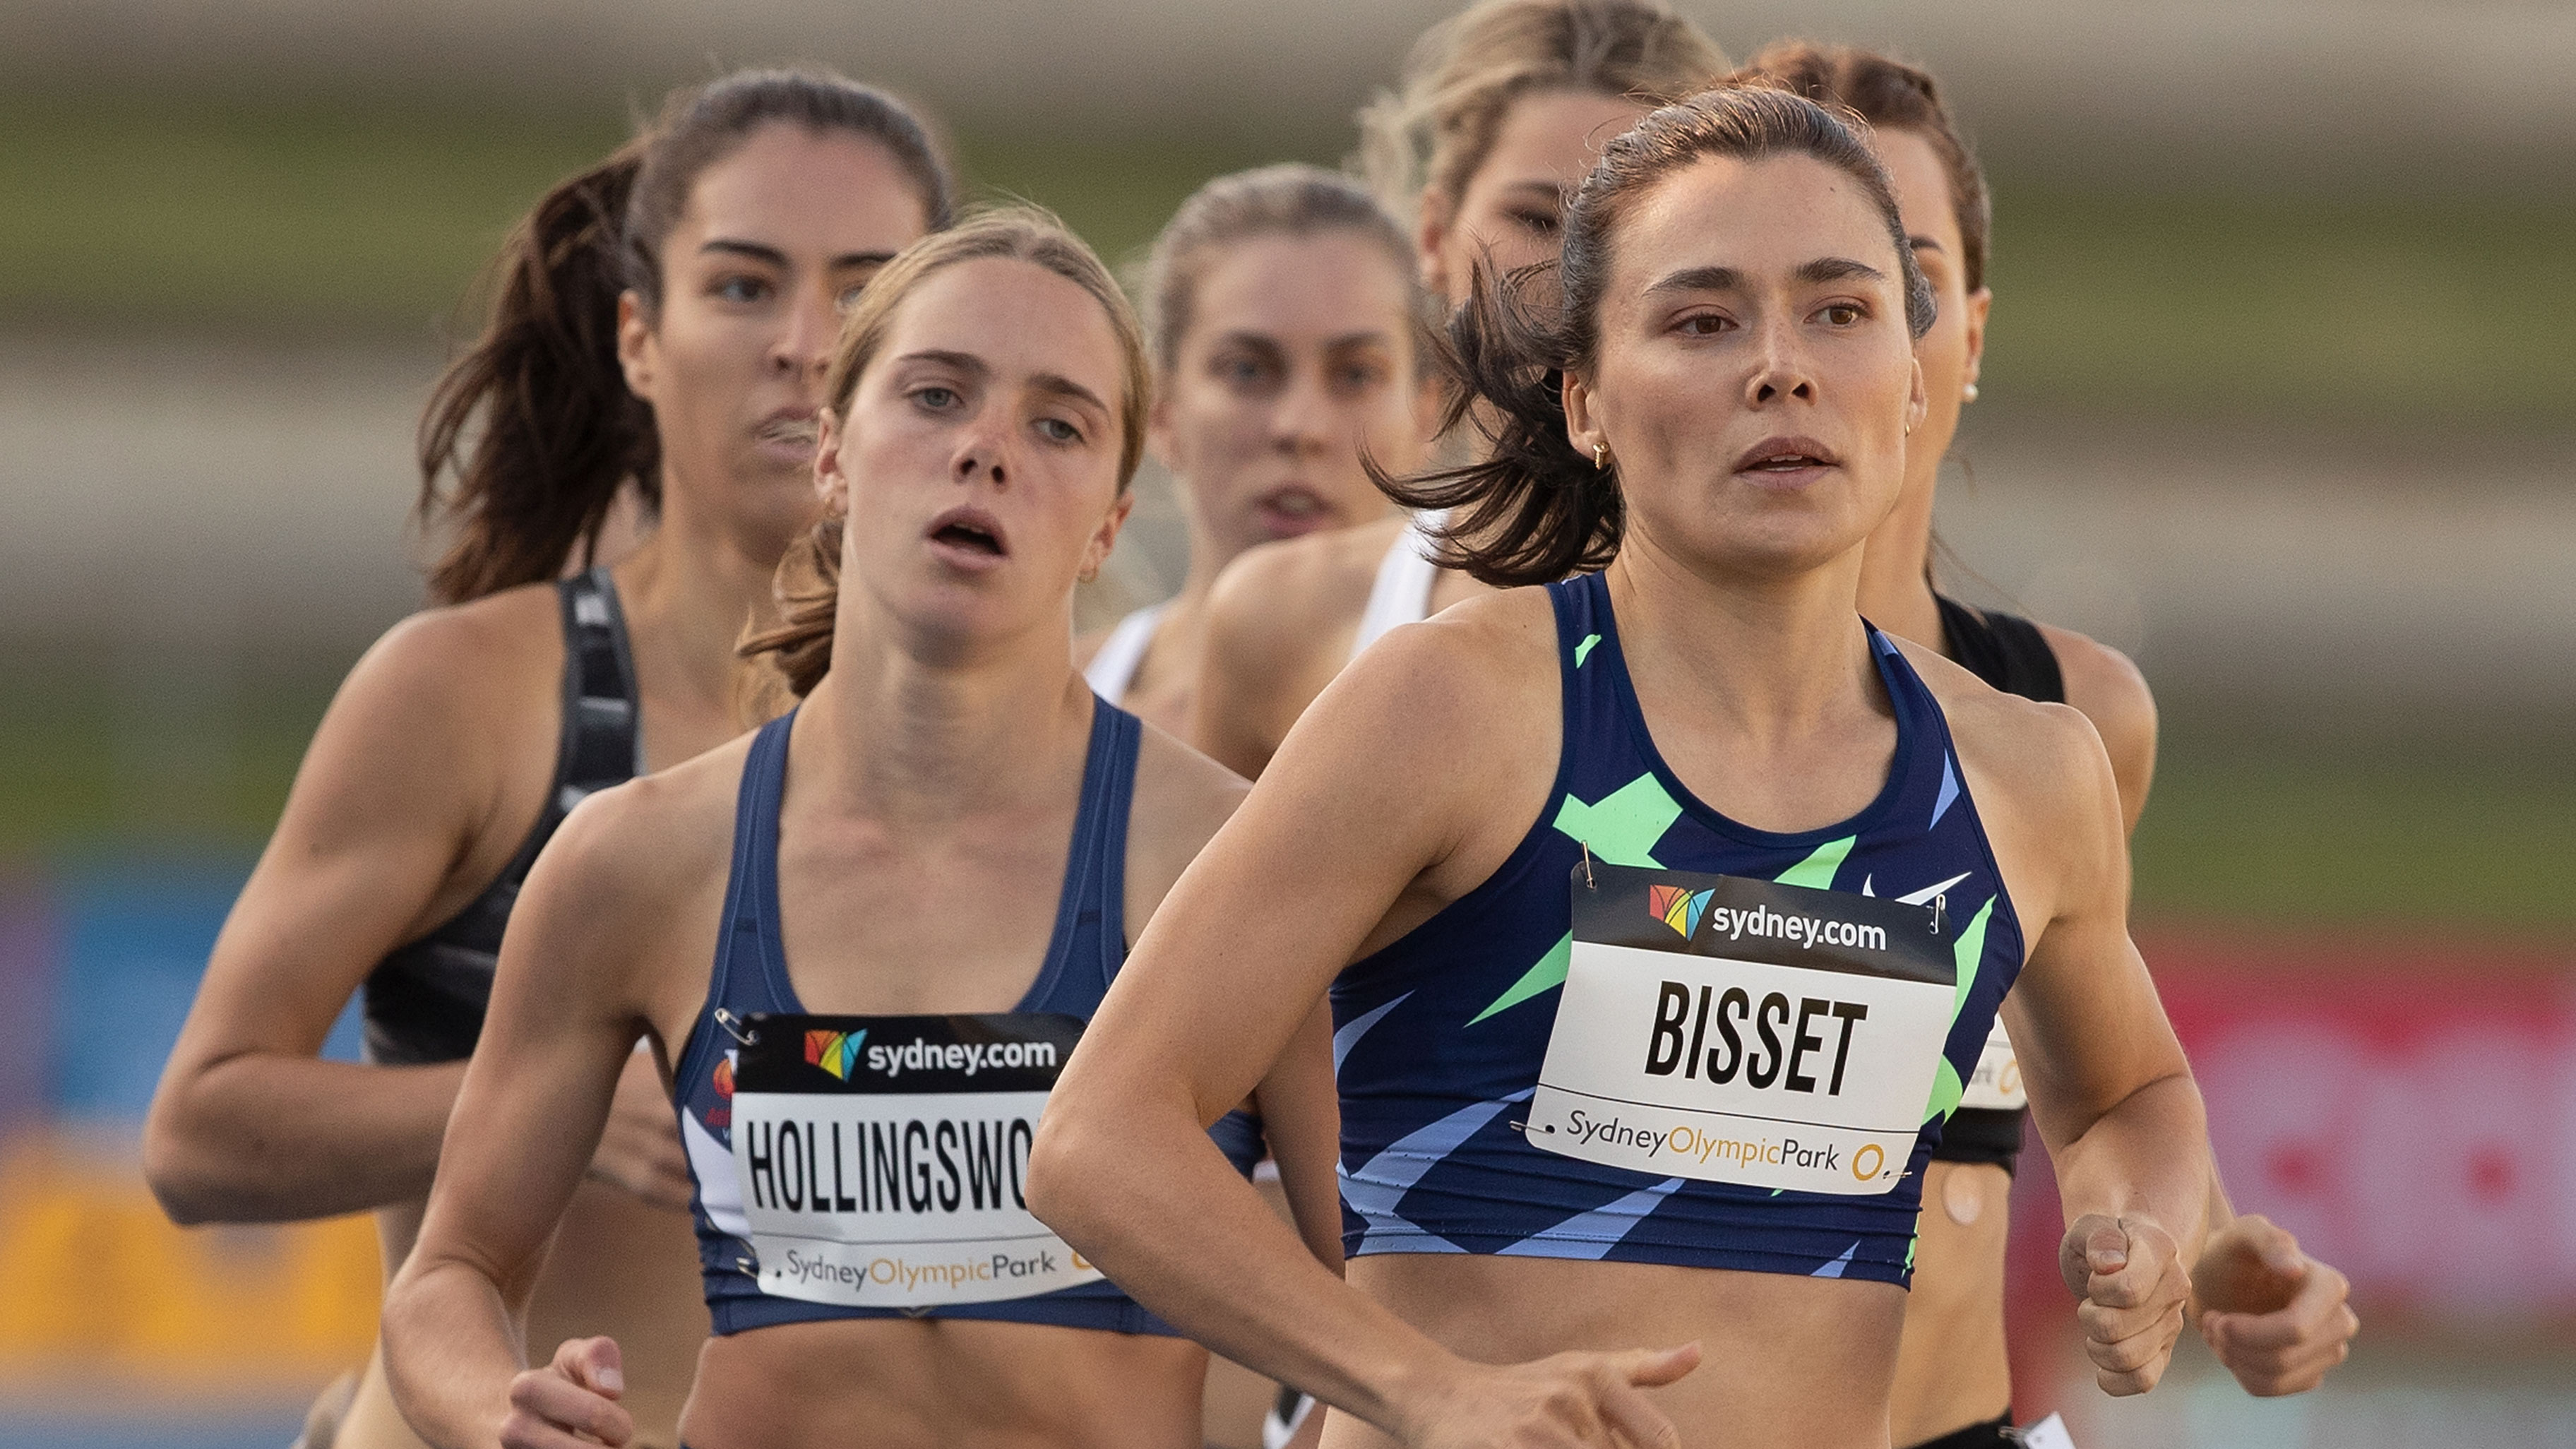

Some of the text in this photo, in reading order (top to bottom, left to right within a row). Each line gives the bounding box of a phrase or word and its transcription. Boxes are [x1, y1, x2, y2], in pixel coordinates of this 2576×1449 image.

[1713, 905, 1885, 950] sydney.com
[868, 1038, 1054, 1076] sydney.com
[1645, 980, 1868, 1096] BISSET
[747, 1118, 1039, 1213] HOLLINGSWO
[1567, 1109, 1839, 1171] SydneyOlympicPark
[787, 1249, 1056, 1292] SydneyOlympicPark
